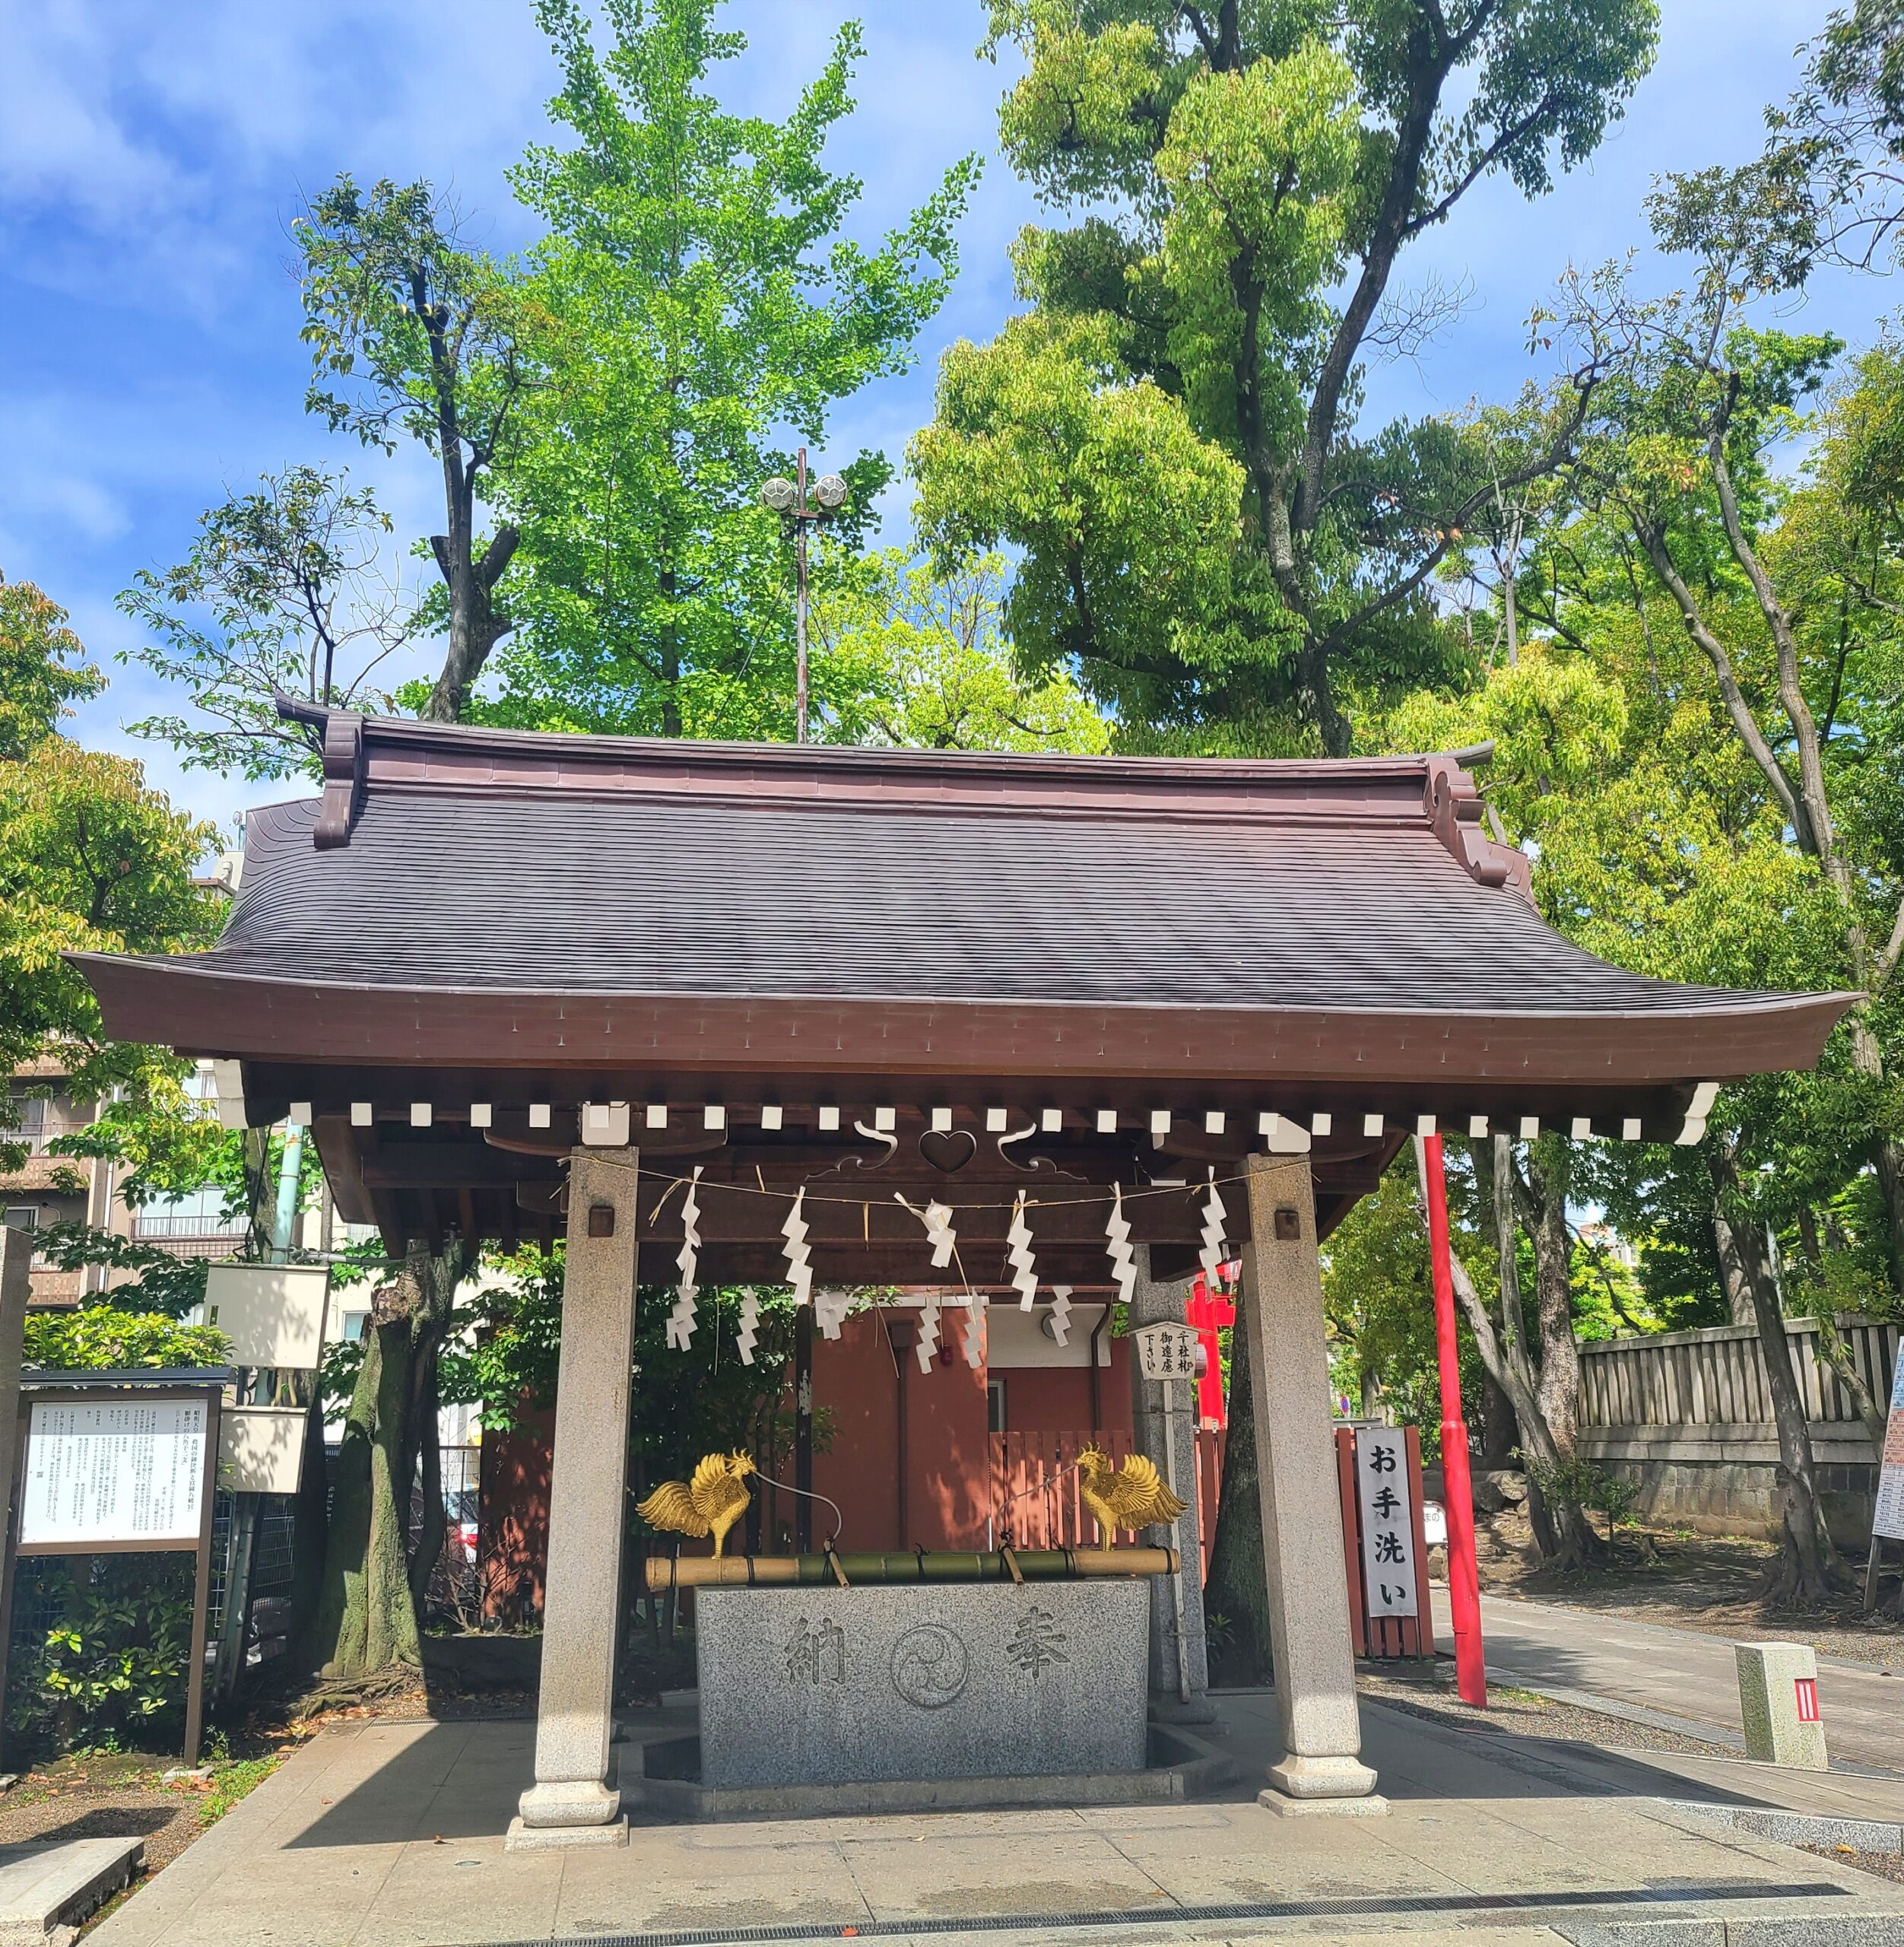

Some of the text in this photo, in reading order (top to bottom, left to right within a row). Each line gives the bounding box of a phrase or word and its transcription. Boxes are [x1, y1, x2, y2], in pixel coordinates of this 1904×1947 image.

[1144, 1334, 1156, 1371] 下さい
[1160, 1331, 1174, 1373] 御遠慮
[1177, 1330, 1194, 1373] 千社札
[1369, 1445, 1406, 1606] お手洗い
[784, 1606, 1070, 1685] 奉 納
